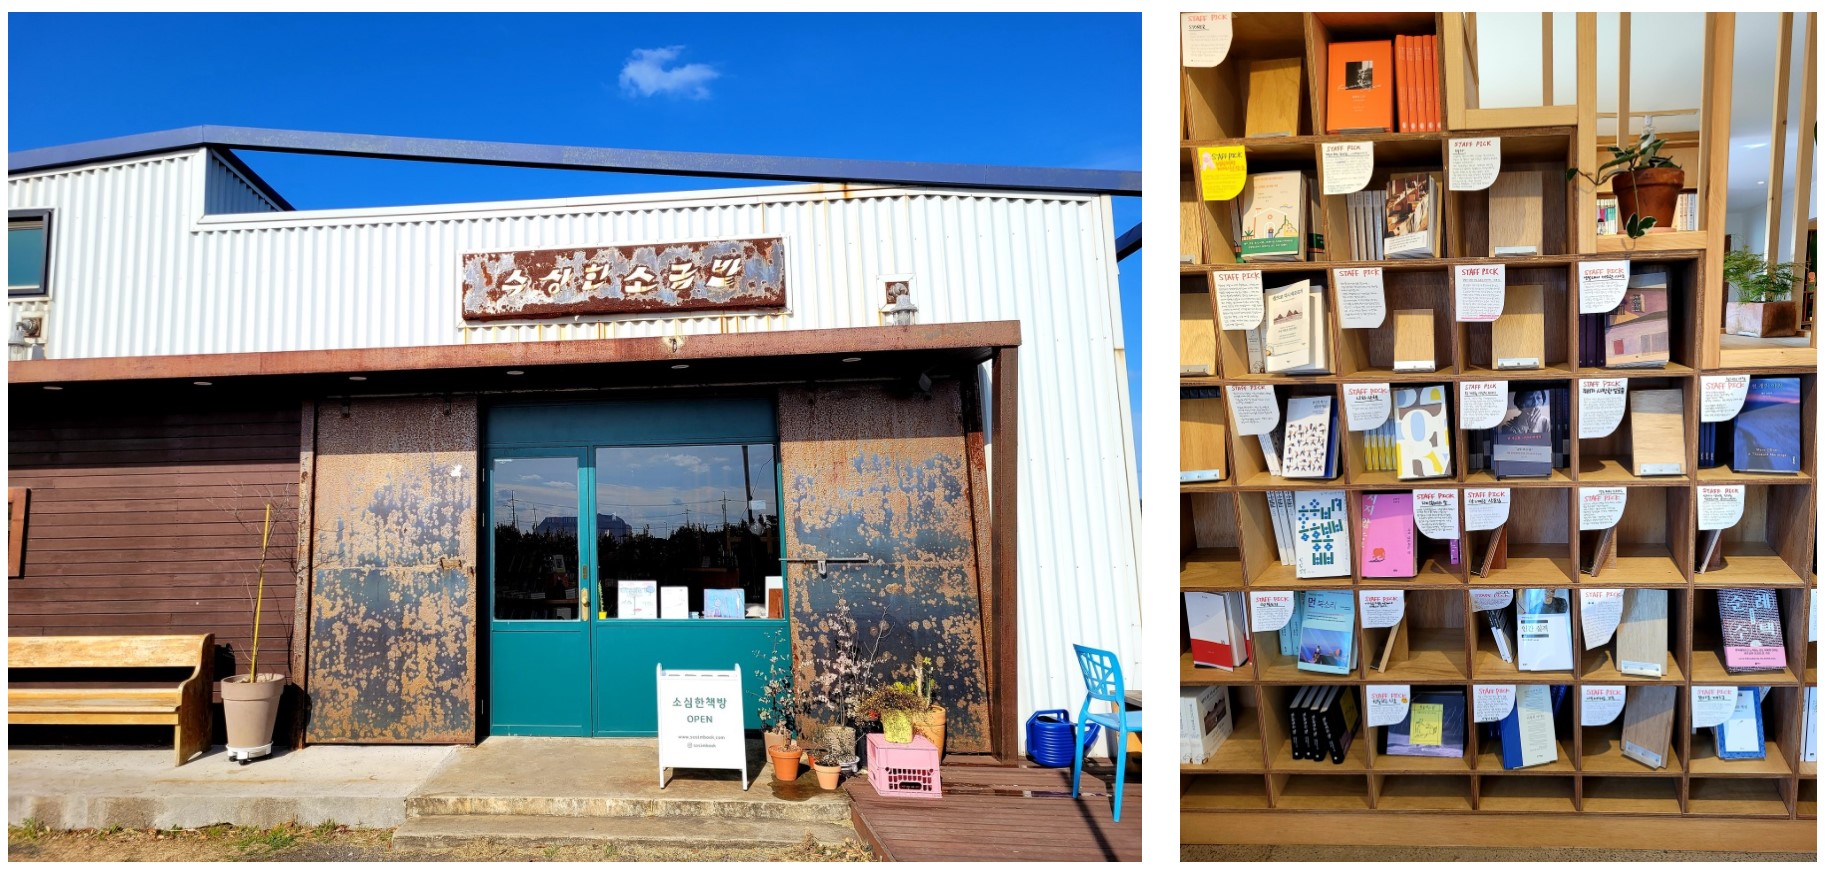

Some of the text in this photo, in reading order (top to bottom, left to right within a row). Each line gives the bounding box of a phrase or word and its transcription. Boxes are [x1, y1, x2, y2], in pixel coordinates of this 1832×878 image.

[1338, 269, 1380, 278] STAFF PICK
[1461, 268, 1499, 276] STAFF PICK
[1218, 272, 1260, 282] STAFF PICK
[1706, 381, 1745, 390] STAFF PICK
[1348, 388, 1368, 396] STAFF
[672, 697, 727, 709] 소심한책방
[687, 715, 713, 723] OPEN
